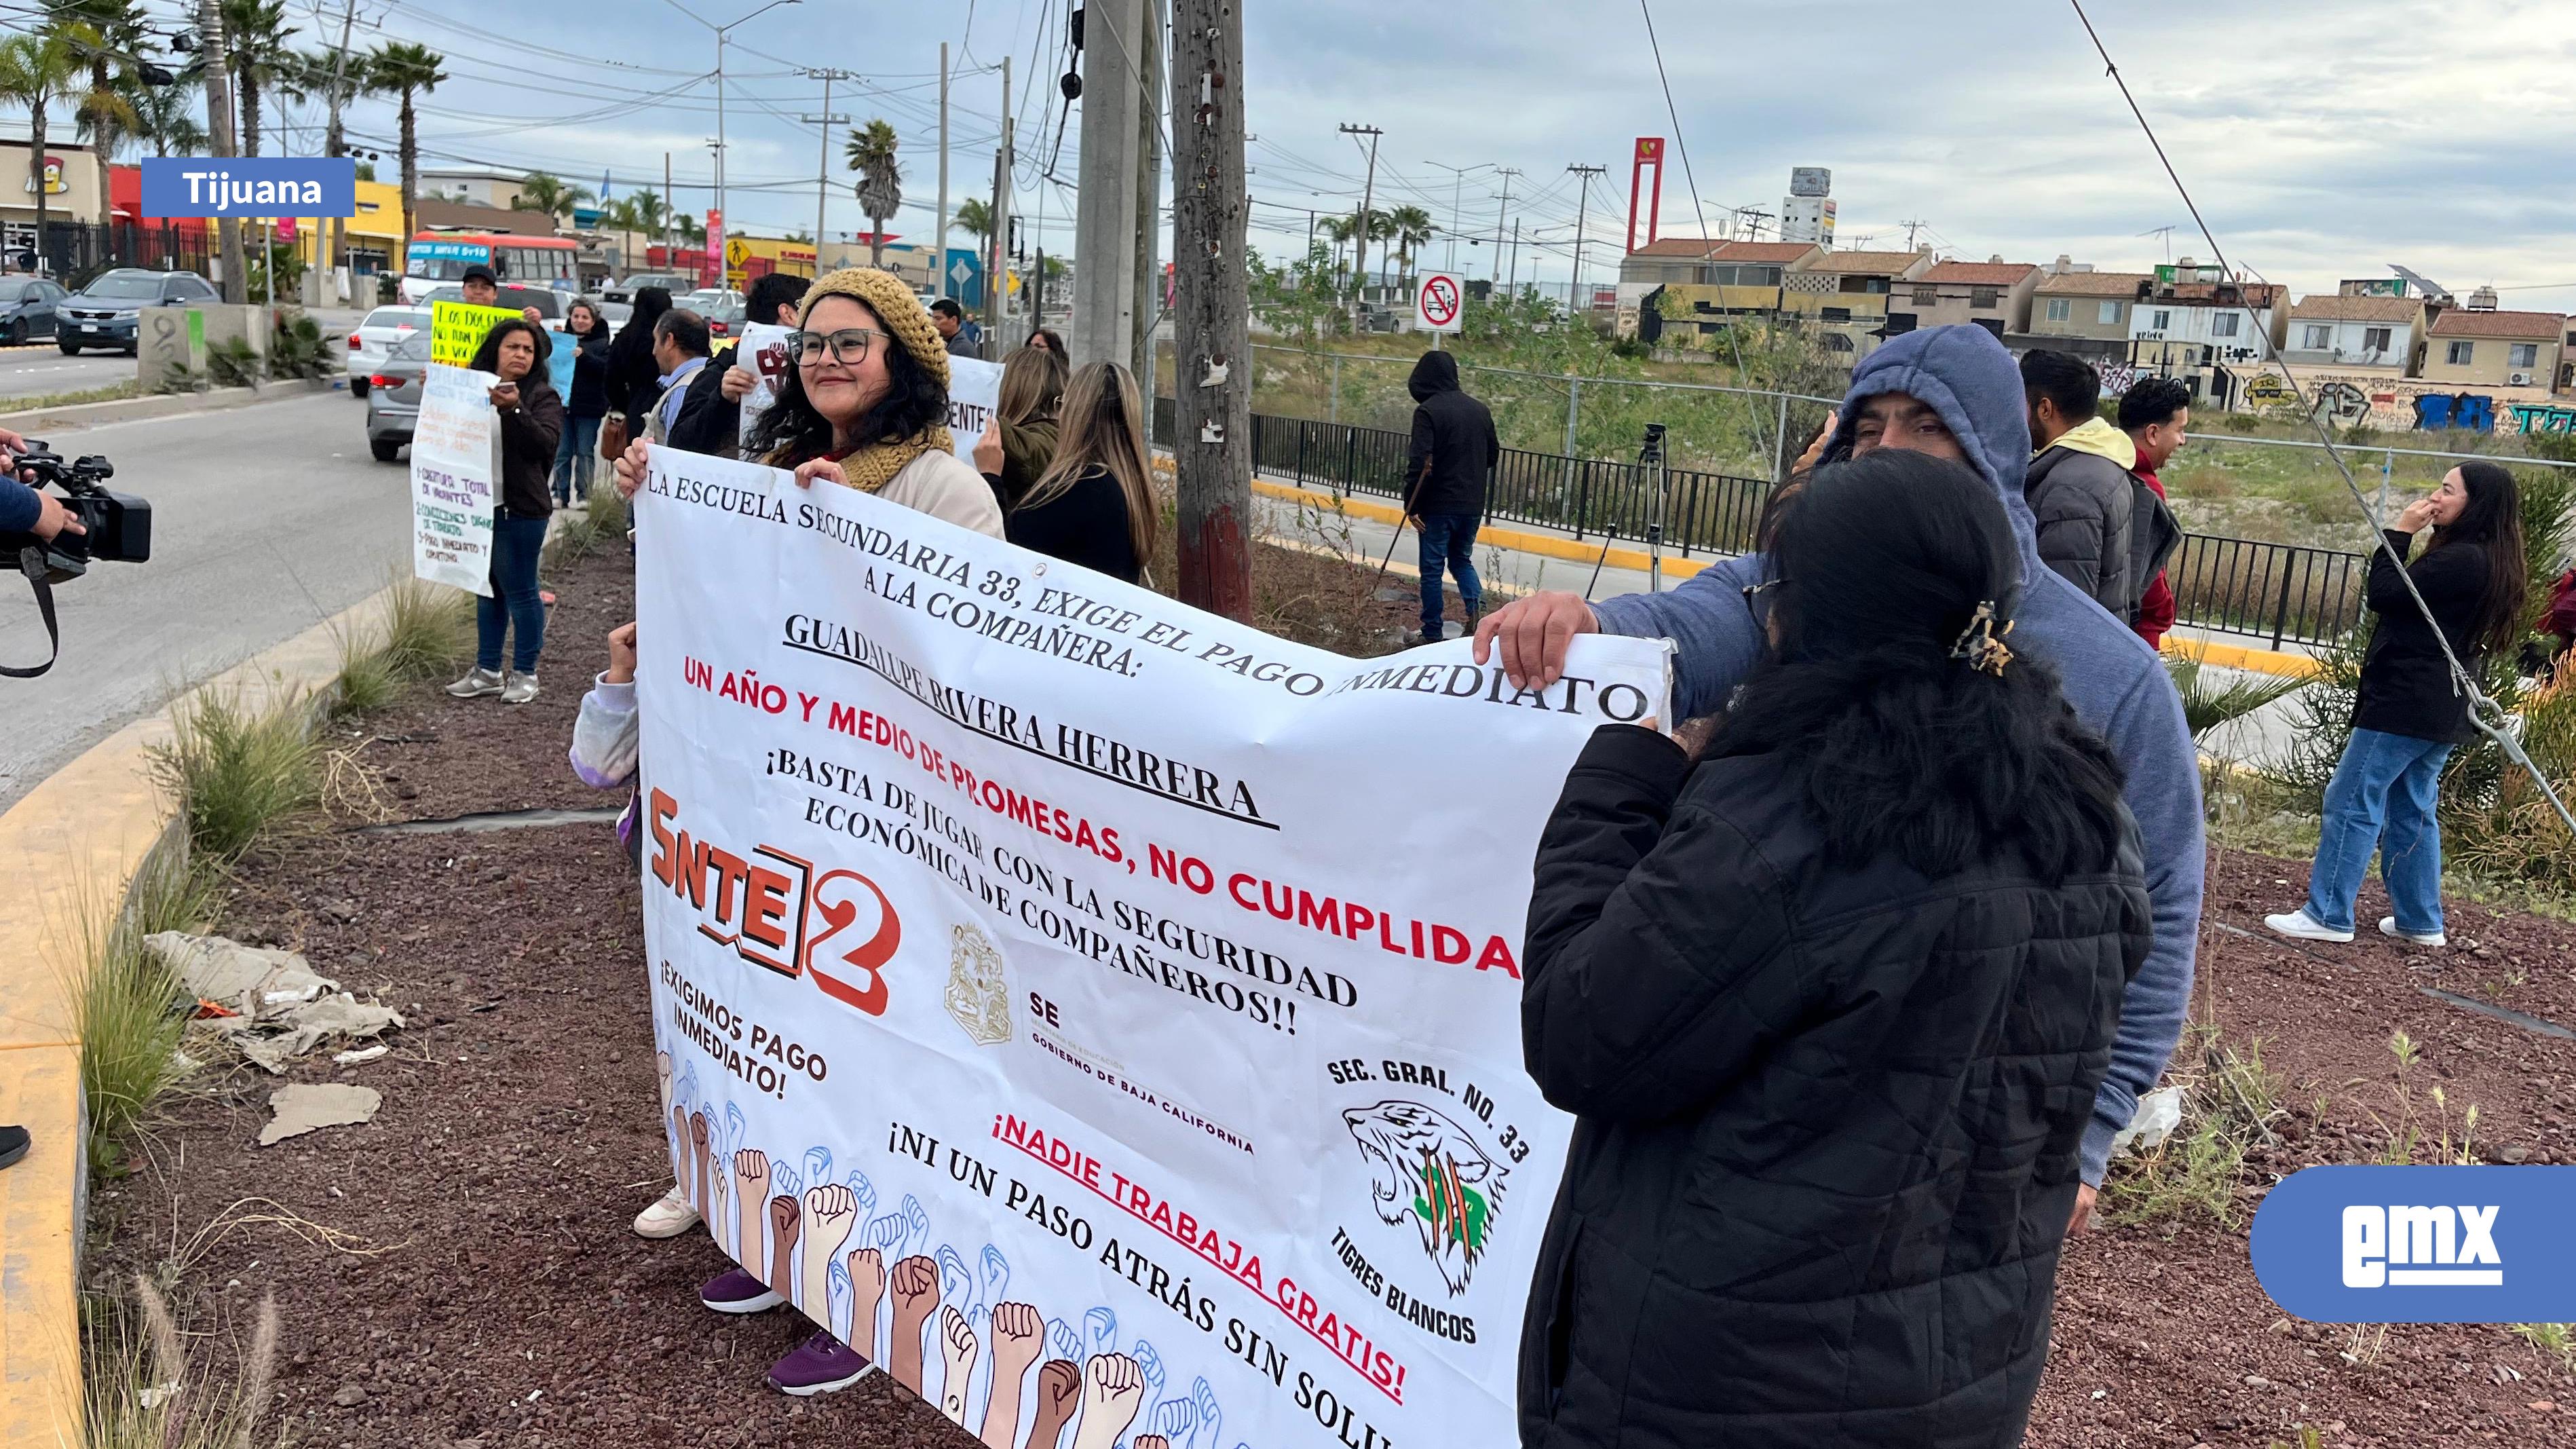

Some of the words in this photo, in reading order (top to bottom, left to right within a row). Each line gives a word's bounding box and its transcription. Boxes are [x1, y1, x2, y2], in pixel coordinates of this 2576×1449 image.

[950, 401, 993, 434] ENTE"
[647, 470, 669, 497] LA
[675, 477, 789, 525] ESCUELA
[798, 503, 970, 588] SECUNDARIA
[978, 569, 1023, 609] 33,
[1031, 587, 1141, 634] EXIGE
[1137, 620, 1194, 653] EL
[1196, 642, 1325, 697] PAGO
[864, 566, 877, 595] A
[882, 572, 917, 610] LA
[926, 592, 1144, 679] COMPAÑERA:
[785, 614, 928, 700] GUADALUPE
[928, 677, 1046, 751] RIVERA
[1057, 723, 1263, 819] HERRERA
[684, 656, 713, 692] UN
[719, 669, 787, 714] AÑO
[797, 692, 820, 723] Y
[828, 702, 915, 761] MEDIO
[920, 740, 947, 783] DE
[950, 760, 1137, 875] PROMESAS,
[1148, 843, 1216, 896] NO
[1228, 873, 1521, 981] CUMPLIDA
[766, 748, 874, 802] ¡BASTA
[883, 781, 917, 820] DE
[922, 800, 985, 865] JUGAR
[993, 846, 1054, 897] CON
[1063, 876, 1105, 920] LA
[1114, 900, 1357, 1008] SEGURIDAD
[649, 786, 793, 952] SNTE
[806, 868, 901, 1017] 2
[805, 797, 974, 893] ECONÓMICA
[979, 874, 1011, 916] DE
[1019, 899, 1295, 1036] COMPAÑEROS!!
[661, 956, 744, 1041] ¡EXIGIMOS
[751, 1024, 827, 1082] PAGO
[674, 1002, 787, 1100] INMEDIATO!
[1029, 991, 1060, 1030] SE
[1032, 1032, 1092, 1075] GOBIERNO
[1097, 1070, 1115, 1086] DE
[1121, 1081, 1157, 1107] BAJA
[1162, 1102, 1254, 1155] CALIFORNIA
[1327, 1058, 1377, 1085] SEC.
[1382, 1060, 1456, 1097] GRAL.
[1463, 1084, 1495, 1130] NO.
[1498, 1125, 1530, 1164] 33
[889, 1122, 939, 1169] ¡NI
[949, 1148, 998, 1198] UN
[1005, 1178, 1093, 1250] PASO
[1100, 1237, 1217, 1333] ATRÁS
[1224, 1319, 1289, 1389] SIN
[991, 1113, 1102, 1189] ¡NADIE
[1112, 1173, 1264, 1291] TRABAJA
[1276, 1277, 1406, 1397] GRATIS!
[1330, 1226, 1384, 1298] TIGRES
[1386, 1284, 1477, 1344] BLANCOS
